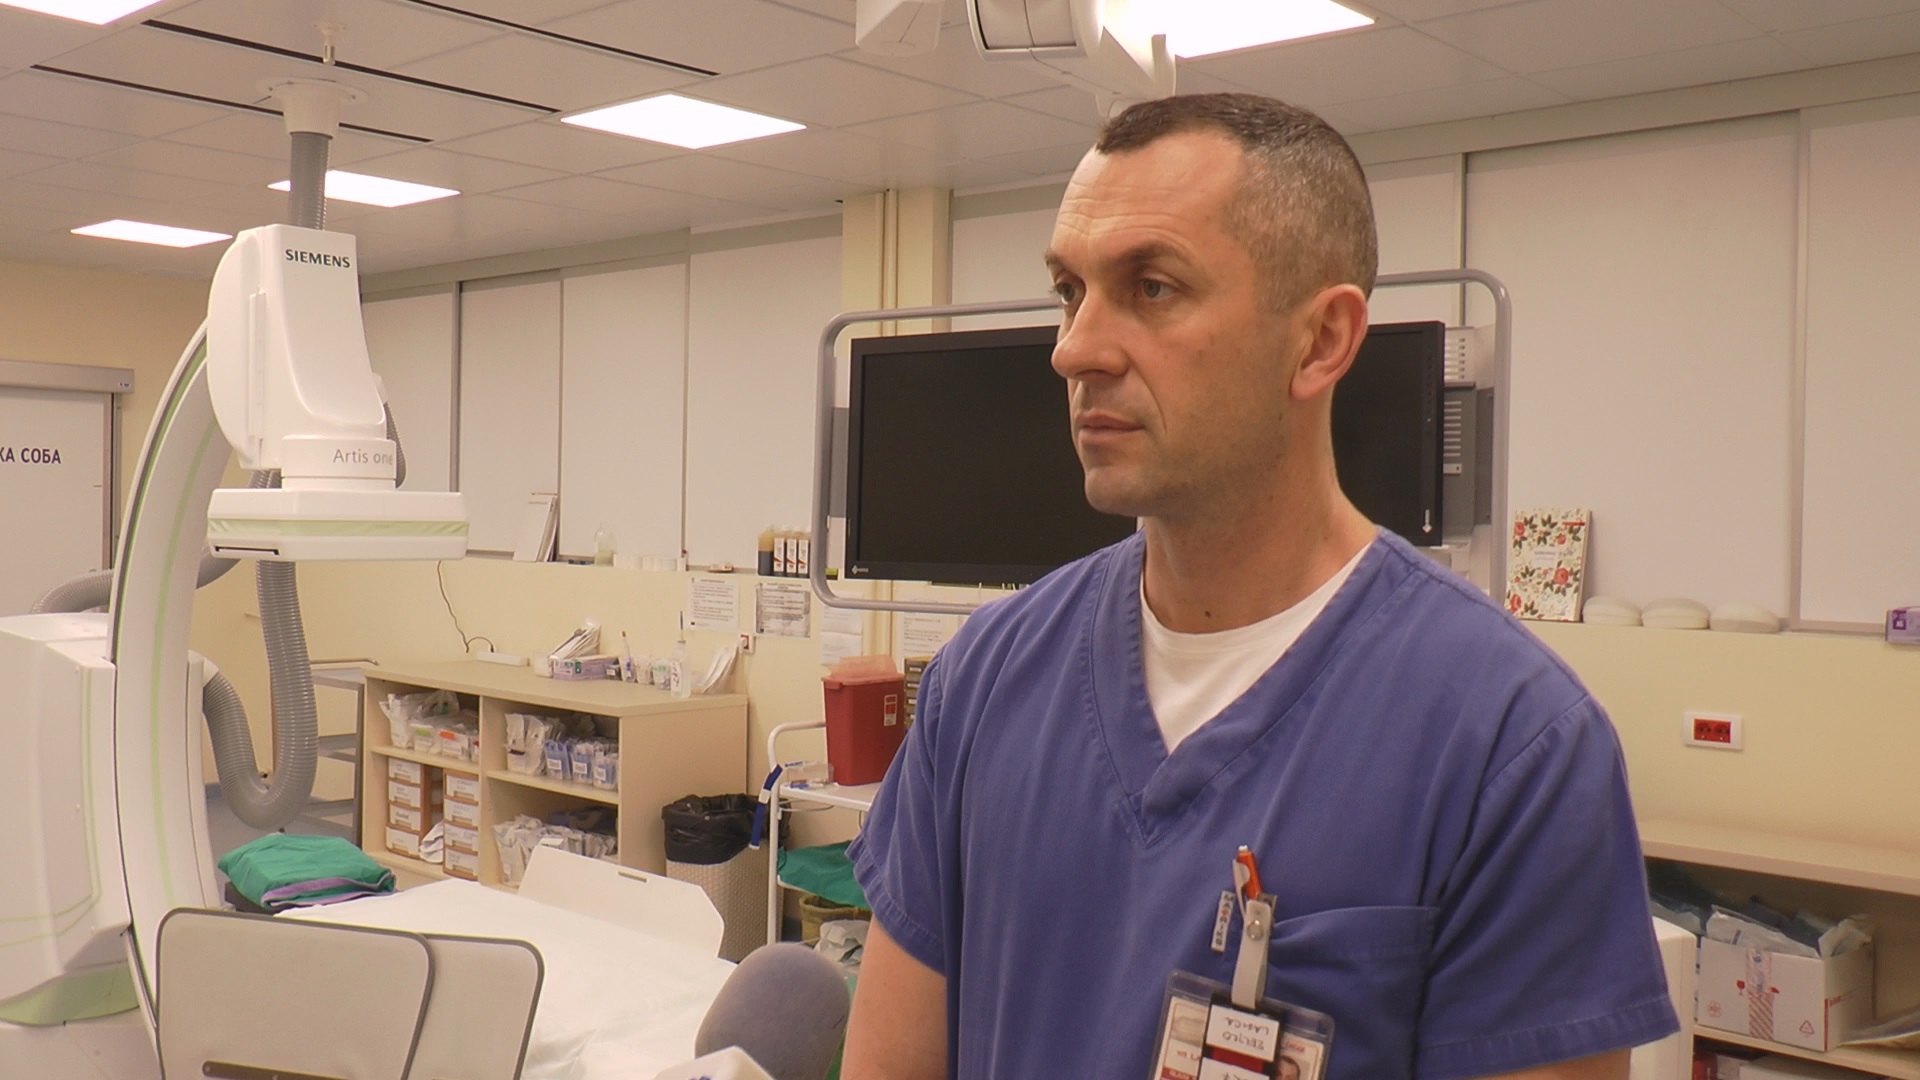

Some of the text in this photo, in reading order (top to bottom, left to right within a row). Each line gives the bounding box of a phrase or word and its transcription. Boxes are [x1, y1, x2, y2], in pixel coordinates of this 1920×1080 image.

[285, 248, 351, 269] SIEMENS
[21, 447, 62, 464] СОБА
[333, 448, 394, 465] Artis one
